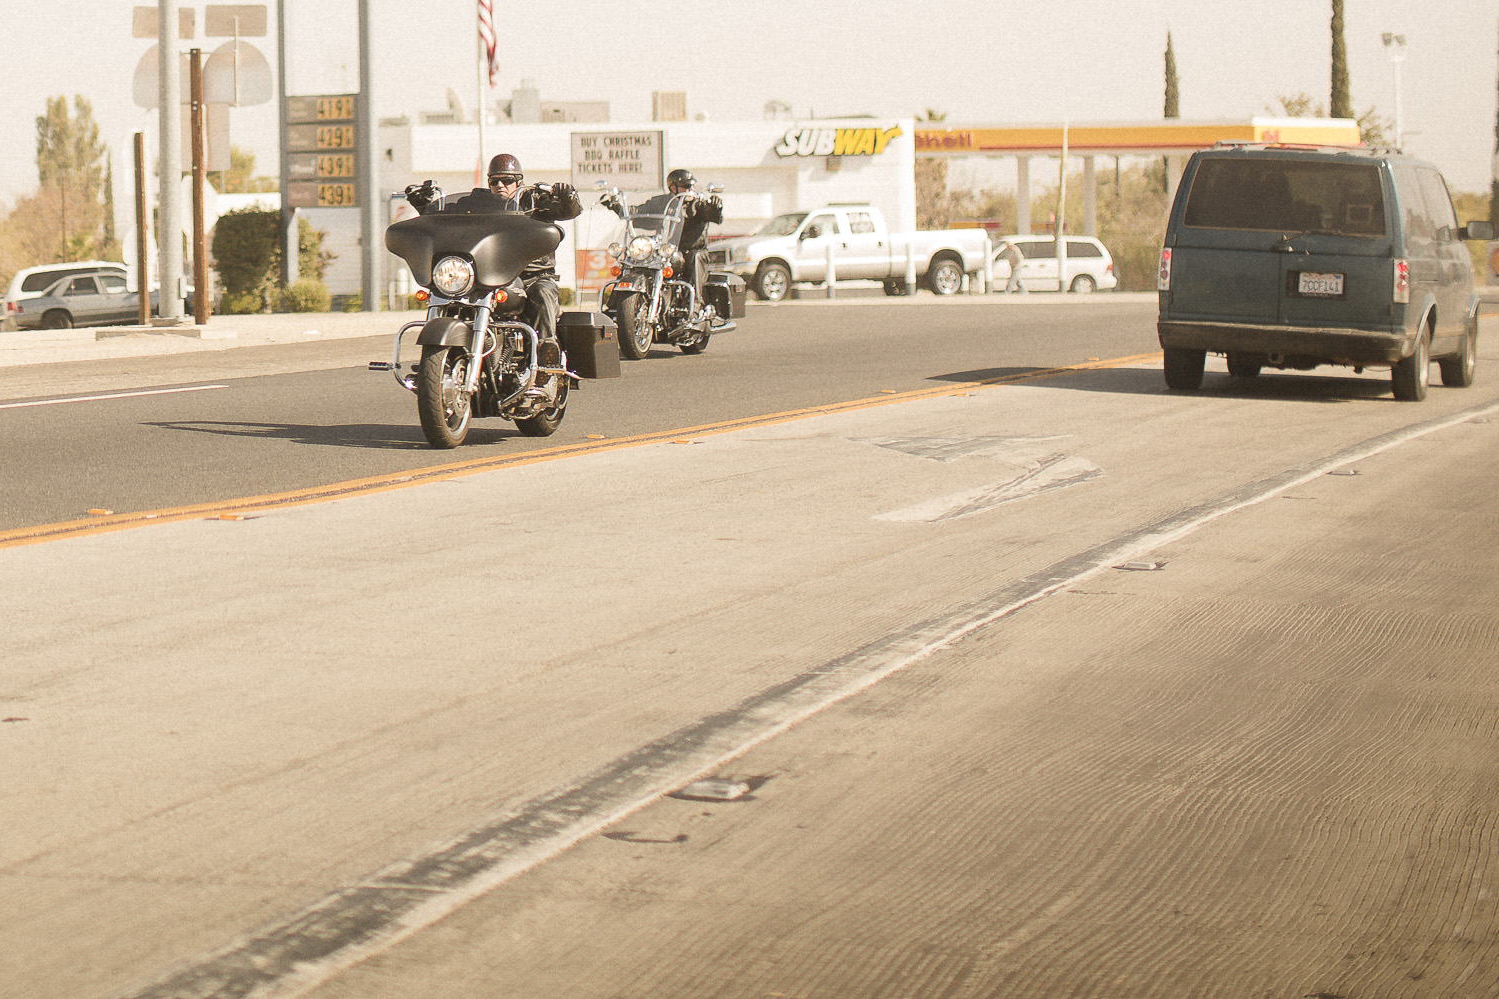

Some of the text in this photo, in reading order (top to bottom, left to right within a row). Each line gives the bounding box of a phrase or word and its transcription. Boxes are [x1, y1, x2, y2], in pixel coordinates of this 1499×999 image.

[581, 135, 652, 147] BUY CHRISTMAS
[775, 124, 902, 157] SUBWAY
[584, 149, 640, 160] BBQ RAFFLE
[578, 162, 642, 173] TICKETS HERE!
[319, 185, 344, 205] 439
